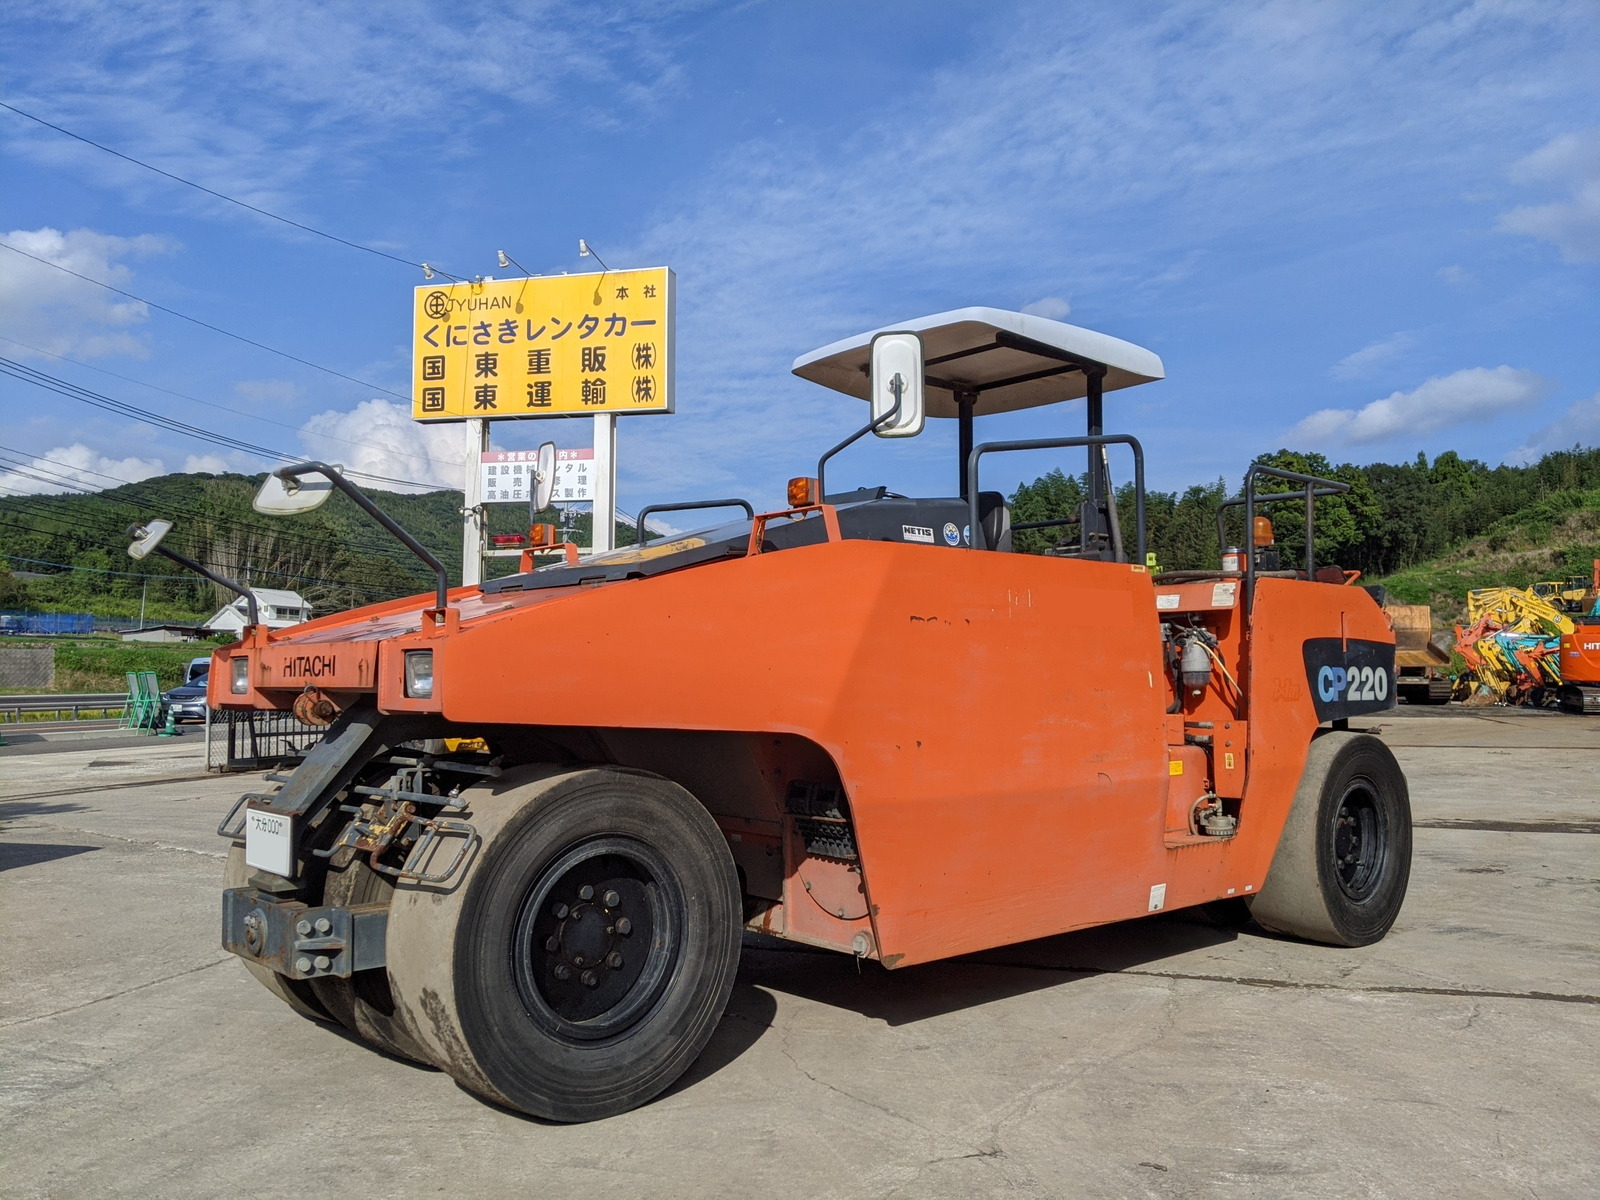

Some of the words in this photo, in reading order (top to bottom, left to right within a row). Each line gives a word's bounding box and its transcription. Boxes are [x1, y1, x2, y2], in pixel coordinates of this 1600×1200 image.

[445, 296, 512, 312] JYUHAN
[423, 313, 657, 348] くにさきレンタカー
[904, 526, 931, 536] NETIS
[283, 654, 336, 678] HITACHI
[1317, 665, 1388, 703] CP220
